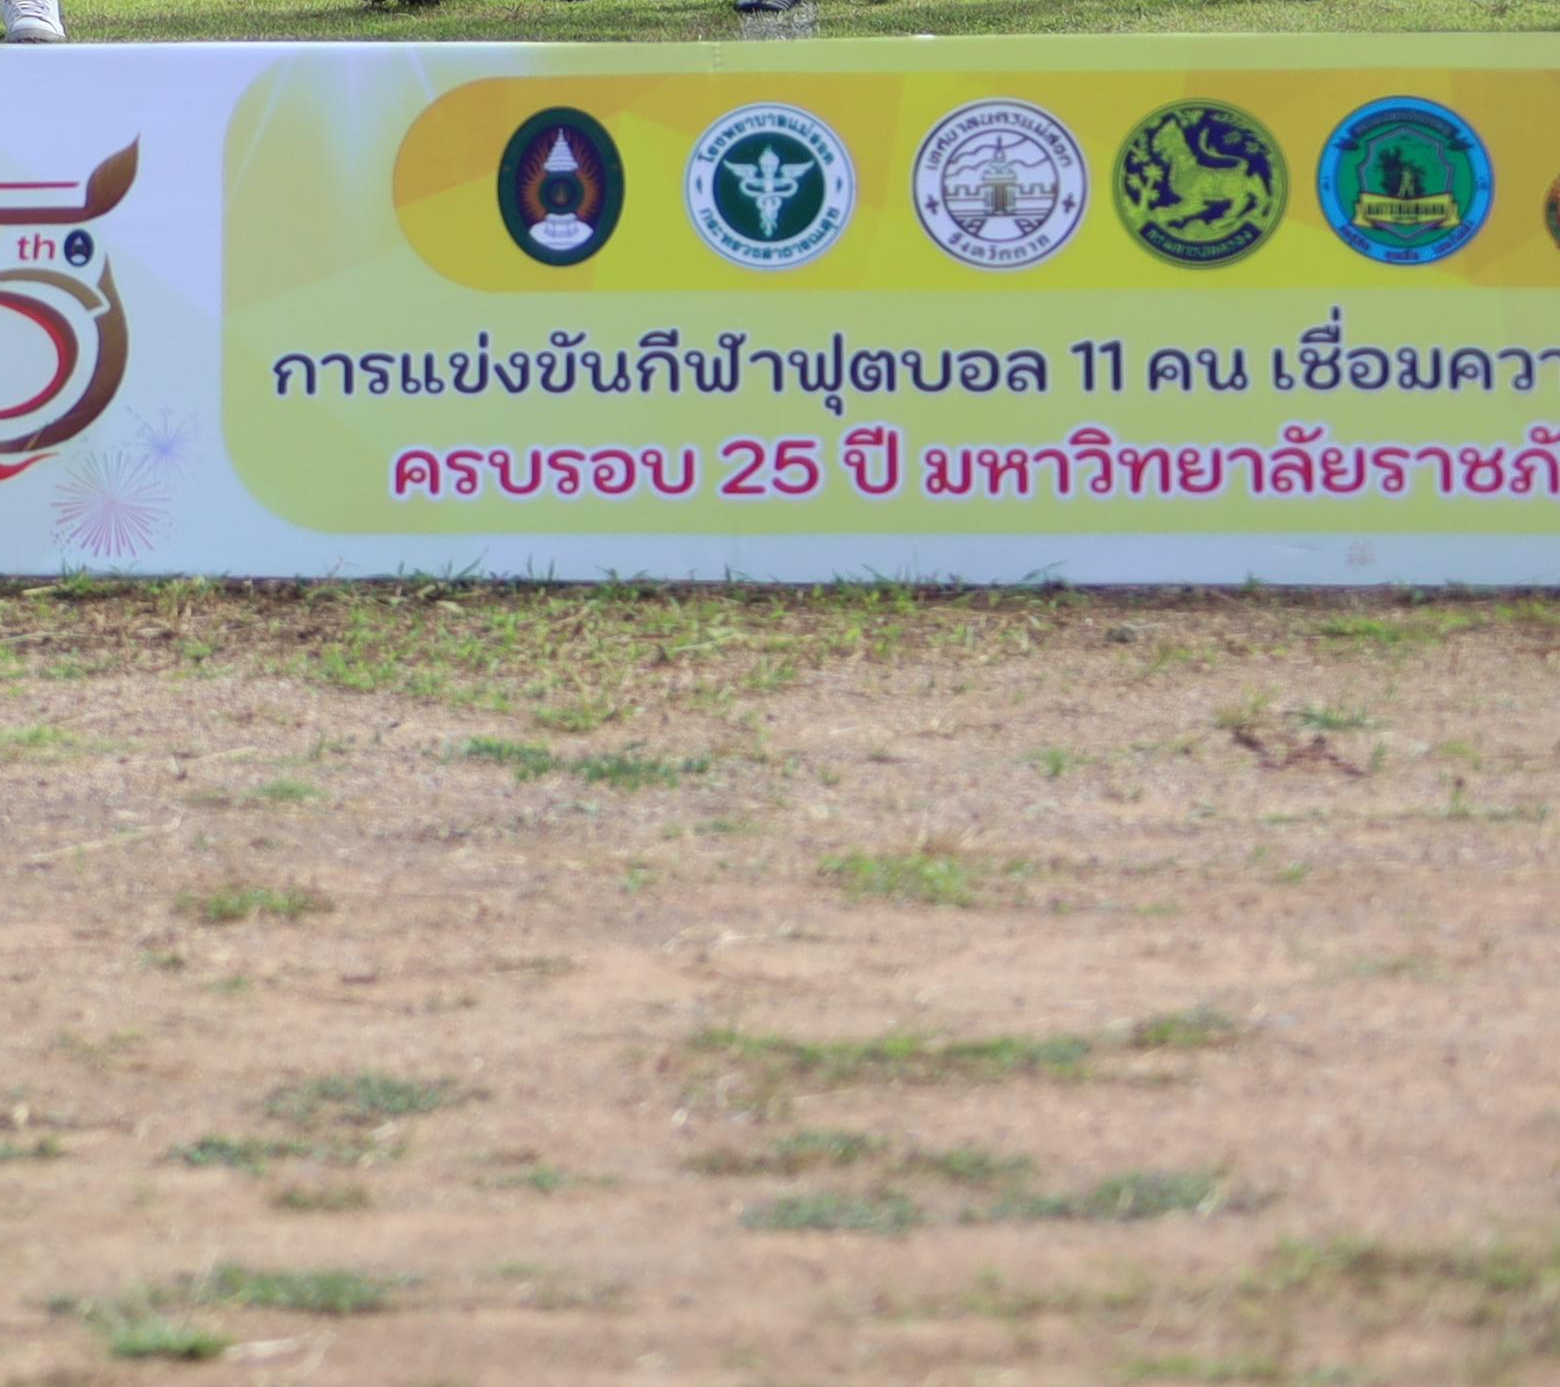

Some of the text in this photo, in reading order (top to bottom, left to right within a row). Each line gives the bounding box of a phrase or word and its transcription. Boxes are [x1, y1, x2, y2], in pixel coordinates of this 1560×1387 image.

[17, 232, 56, 262] th
[273, 330, 1047, 416] การแข่งขันกีฬาฟุตบอล
[1071, 341, 1121, 392] 11
[1148, 348, 1248, 392] คน
[394, 449, 695, 496] ครบรอบ
[722, 440, 820, 496] 25
[845, 428, 898, 496] ปี
